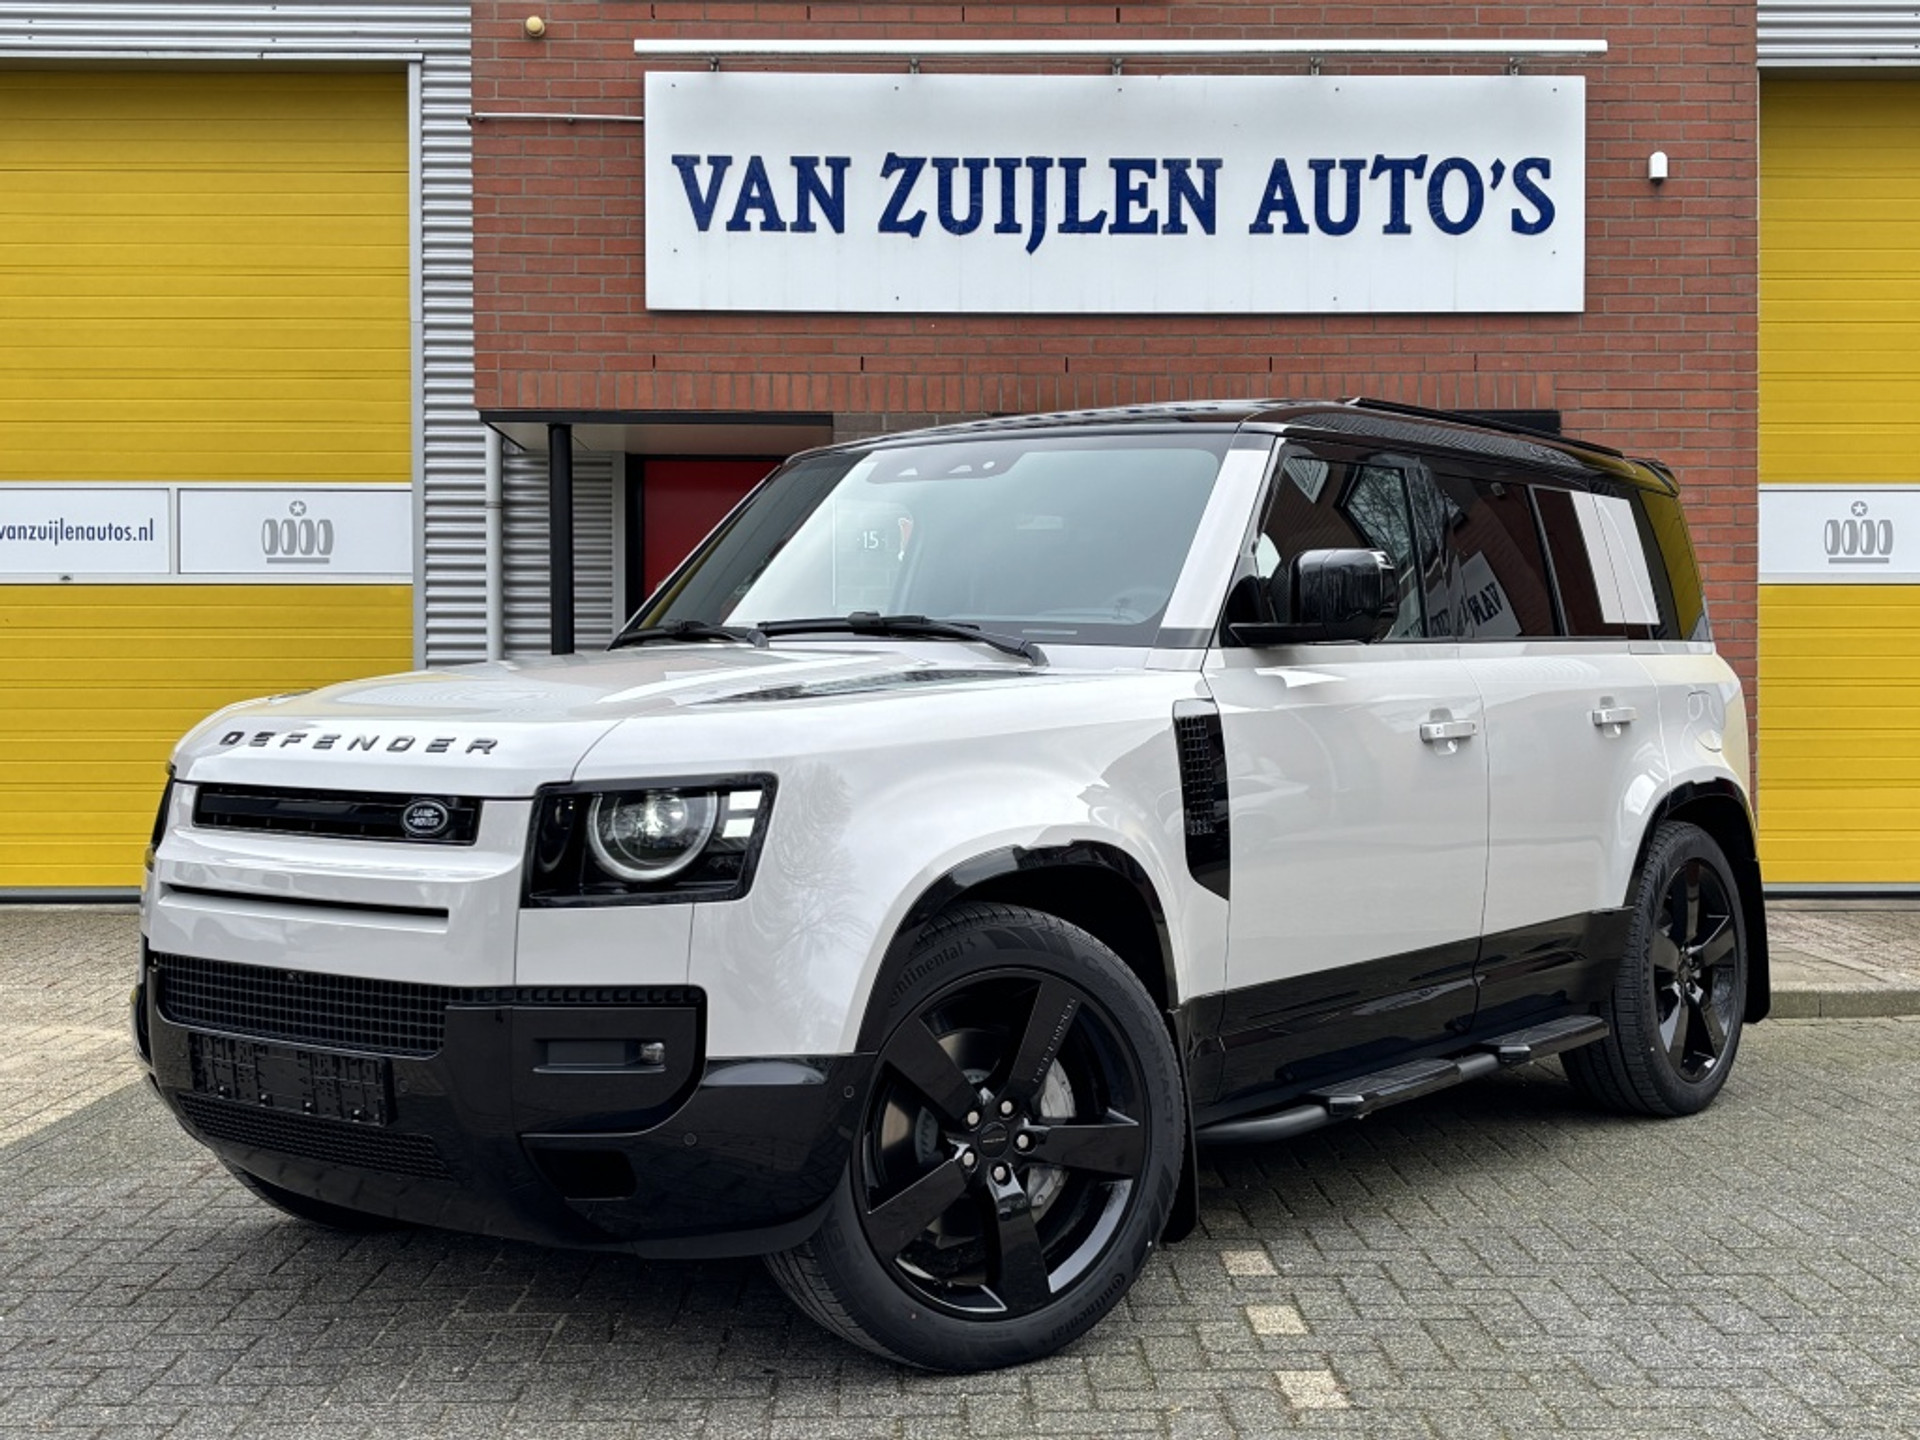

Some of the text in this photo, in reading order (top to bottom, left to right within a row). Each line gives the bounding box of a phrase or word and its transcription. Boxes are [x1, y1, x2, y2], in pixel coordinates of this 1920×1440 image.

[672, 152, 1556, 254] VAN ZUIJLEN AUTO'S
[219, 731, 499, 755] DEFENDER
